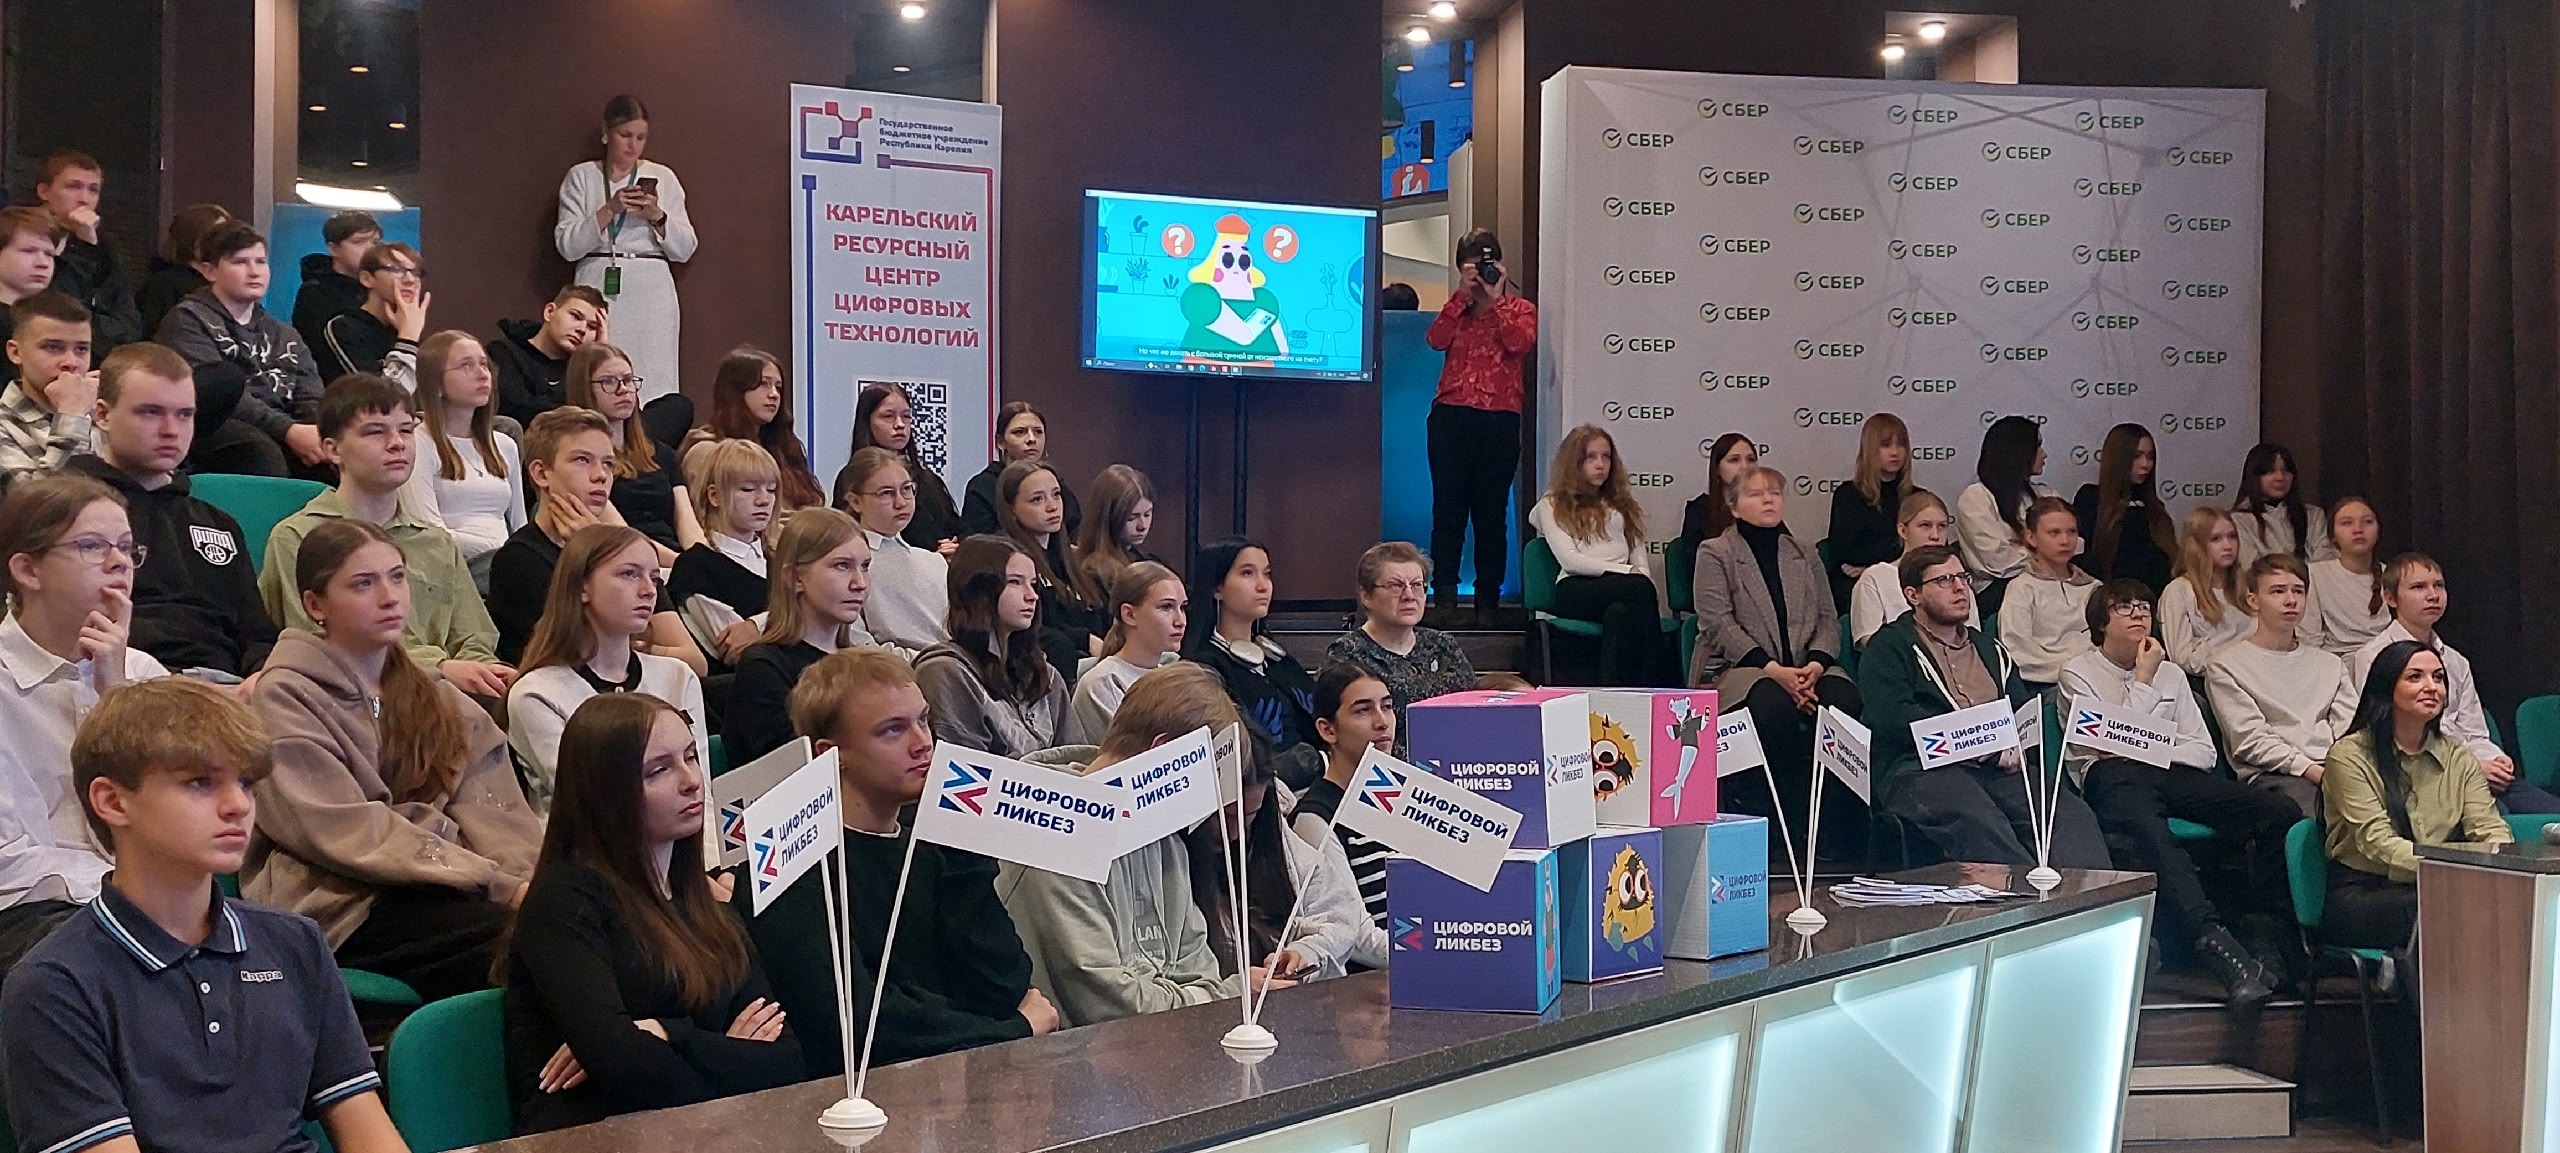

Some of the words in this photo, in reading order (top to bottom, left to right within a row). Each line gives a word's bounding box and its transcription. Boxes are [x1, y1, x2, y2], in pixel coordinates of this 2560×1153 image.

[1722, 103, 1769, 118] СБЕР
[1912, 110, 1958, 123] СБЕР
[879, 117, 954, 132] Государственное
[2099, 116, 2144, 129] СБЕР
[879, 127, 932, 140] бюджетное
[933, 133, 989, 146] учреждение
[1627, 133, 1674, 147] СБЕР
[879, 137, 932, 150] Республики
[934, 143, 973, 154] Карелия
[1818, 140, 1865, 154] СБЕР
[2006, 147, 2051, 160] СБЕР
[2189, 152, 2233, 165] СБЕР
[1723, 171, 1770, 185] СБЕР
[1912, 177, 1958, 191] СБЕР
[2098, 183, 2142, 195] СБЕР
[1628, 202, 1675, 216] СБЕР
[1818, 208, 1865, 222] СБЕР
[826, 204, 977, 232] КАРЕЛЬСКИЙ
[2005, 214, 2050, 226] СБЕР
[2187, 218, 2231, 231] СБЕР
[833, 234, 970, 261] РЕСУРСНЫЙ
[1724, 240, 1770, 254] СБЕР
[1912, 244, 1957, 257] СБЕР
[2096, 250, 2141, 263] СБЕР
[865, 266, 941, 287] ЦЕНТР
[1629, 271, 1676, 284] СБЕР
[1818, 276, 1865, 290] СБЕР
[2004, 280, 2049, 293] СБЕР
[2185, 284, 2229, 298] СБЕР
[834, 293, 972, 319] ЦИФРОВЫХ
[1724, 307, 1770, 321] СБЕР
[1911, 312, 1957, 325] СБЕР
[2095, 316, 2139, 329] СБЕР
[824, 322, 979, 348] ТЕХНОЛОГИЙ
[1628, 339, 1676, 353] СБЕР
[1818, 344, 1865, 358] СБЕР
[2004, 348, 2048, 361] СБЕР
[2184, 351, 2227, 364] СБЕР
[1724, 375, 1770, 389] СБЕР
[1911, 380, 1957, 393] СБЕР
[2094, 383, 2139, 396] СБЕР
[1627, 406, 1675, 420] СБЕР
[1818, 412, 1863, 425] СБЕР
[2183, 417, 2226, 430] СБЕР
[1911, 448, 1956, 460] СБЕР
[2182, 484, 2225, 497] СБЕР
[192, 528, 234, 552] PUMA
[1950, 716, 2011, 740] ЦИФРОВОЙ
[2107, 719, 2171, 746] ЦИФРОВОЙ
[1954, 733, 1997, 751] ЛИКБЕЗ
[2104, 730, 2149, 750] ЛИКБЕЗ
[1837, 738, 1868, 775] ЦИФРОВОЙ
[1131, 744, 1207, 791] ЦИФРОВОЙ
[1450, 760, 1540, 777] ЦИФРОВОЙ
[1836, 751, 1859, 778] ЛИКБЕЗ
[1453, 777, 1513, 791] ЛИКБЕЗ
[1136, 775, 1190, 810] ЛИКБЕЗ
[1000, 779, 1116, 822] ЦИФРОВОЙ
[779, 785, 834, 843] ЦИФРОВОЙ
[993, 801, 1075, 834] ЛИКБЕЗ
[1411, 786, 1509, 840] ЦИФРОВОЙ
[1401, 805, 1470, 844] ЛИКБЕЗ
[781, 824, 819, 868] ЛИКБЕЗ
[1728, 869, 1767, 888] ЦИФРОВОЙ
[1729, 886, 1756, 901] ЛИКБЕЗ
[1433, 920, 1533, 937] ЦИФРОВОЙ
[1434, 937, 1502, 952] ЛИКБЕЗ
[240, 970, 284, 983] Kappa
